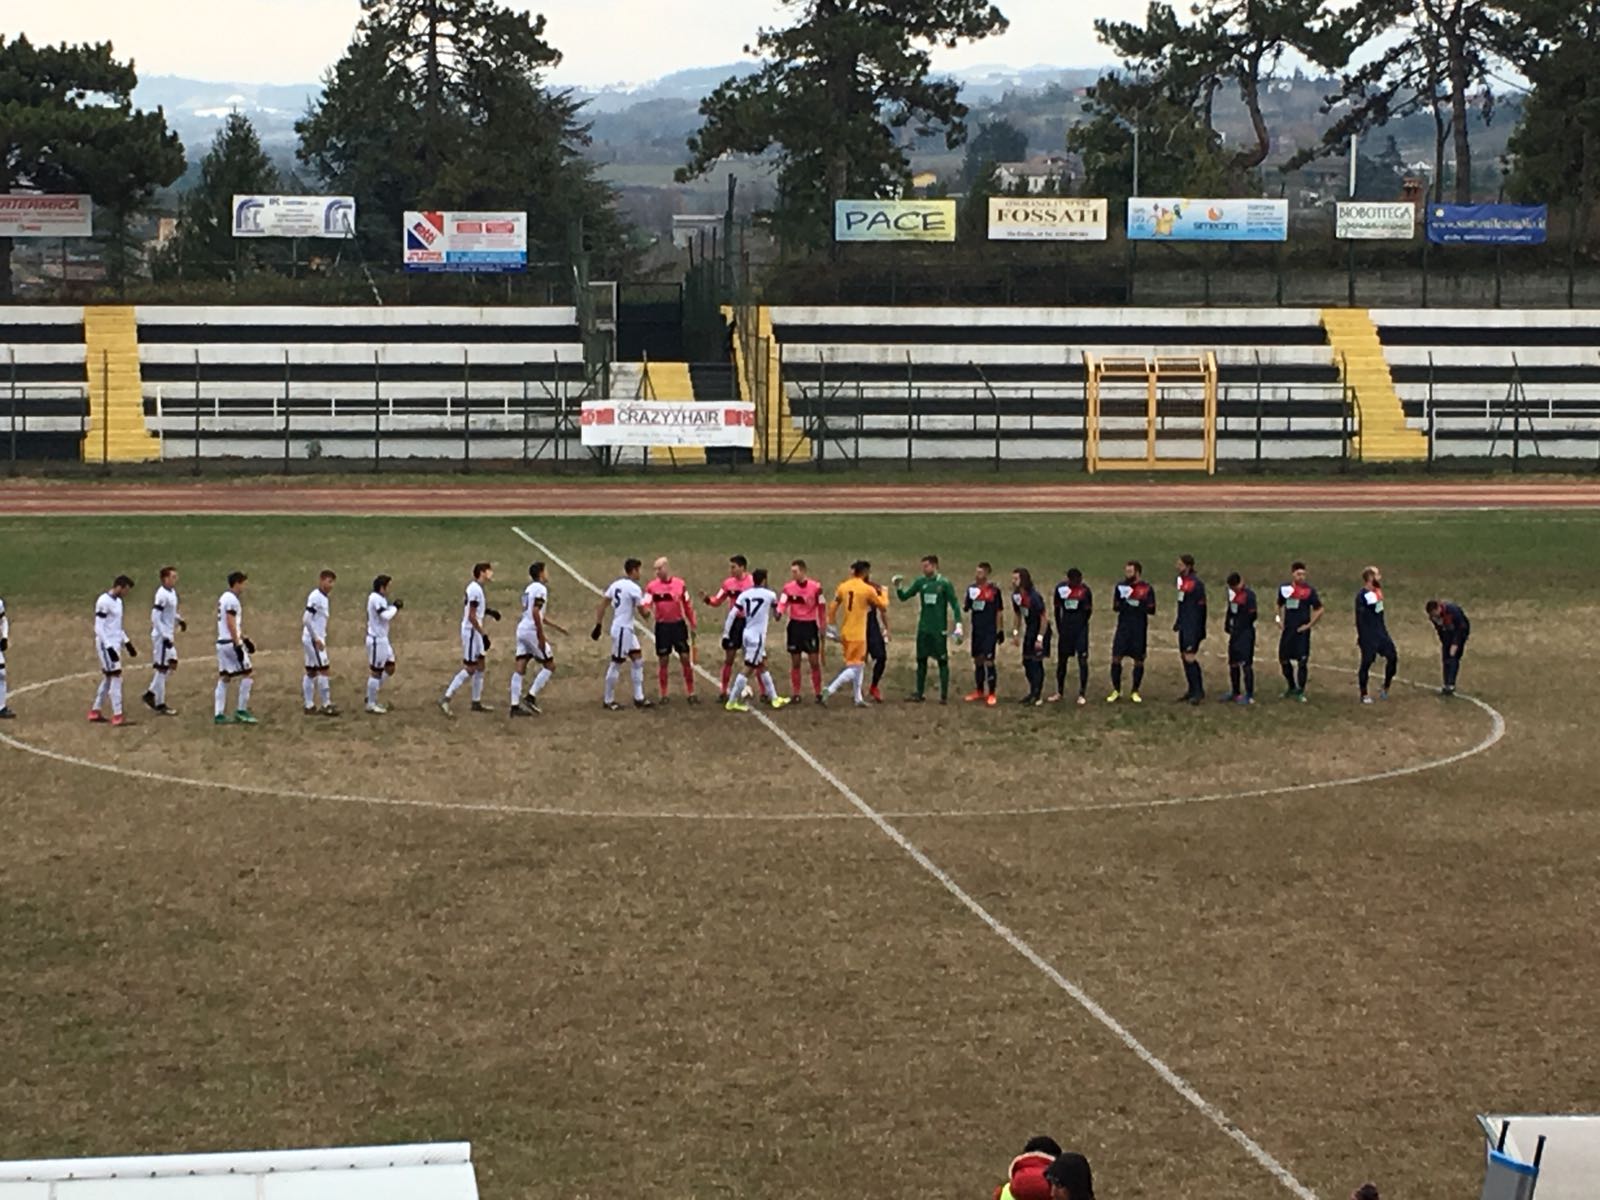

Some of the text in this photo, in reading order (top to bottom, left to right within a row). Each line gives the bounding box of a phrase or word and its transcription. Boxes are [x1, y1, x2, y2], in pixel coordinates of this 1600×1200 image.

[846, 211, 945, 231] PACE
[998, 209, 1098, 222] FOSSATI
[1339, 206, 1412, 218] BIOBOTTEGA
[614, 588, 622, 608] 5
[744, 598, 765, 618] 17
[847, 591, 854, 612] 1
